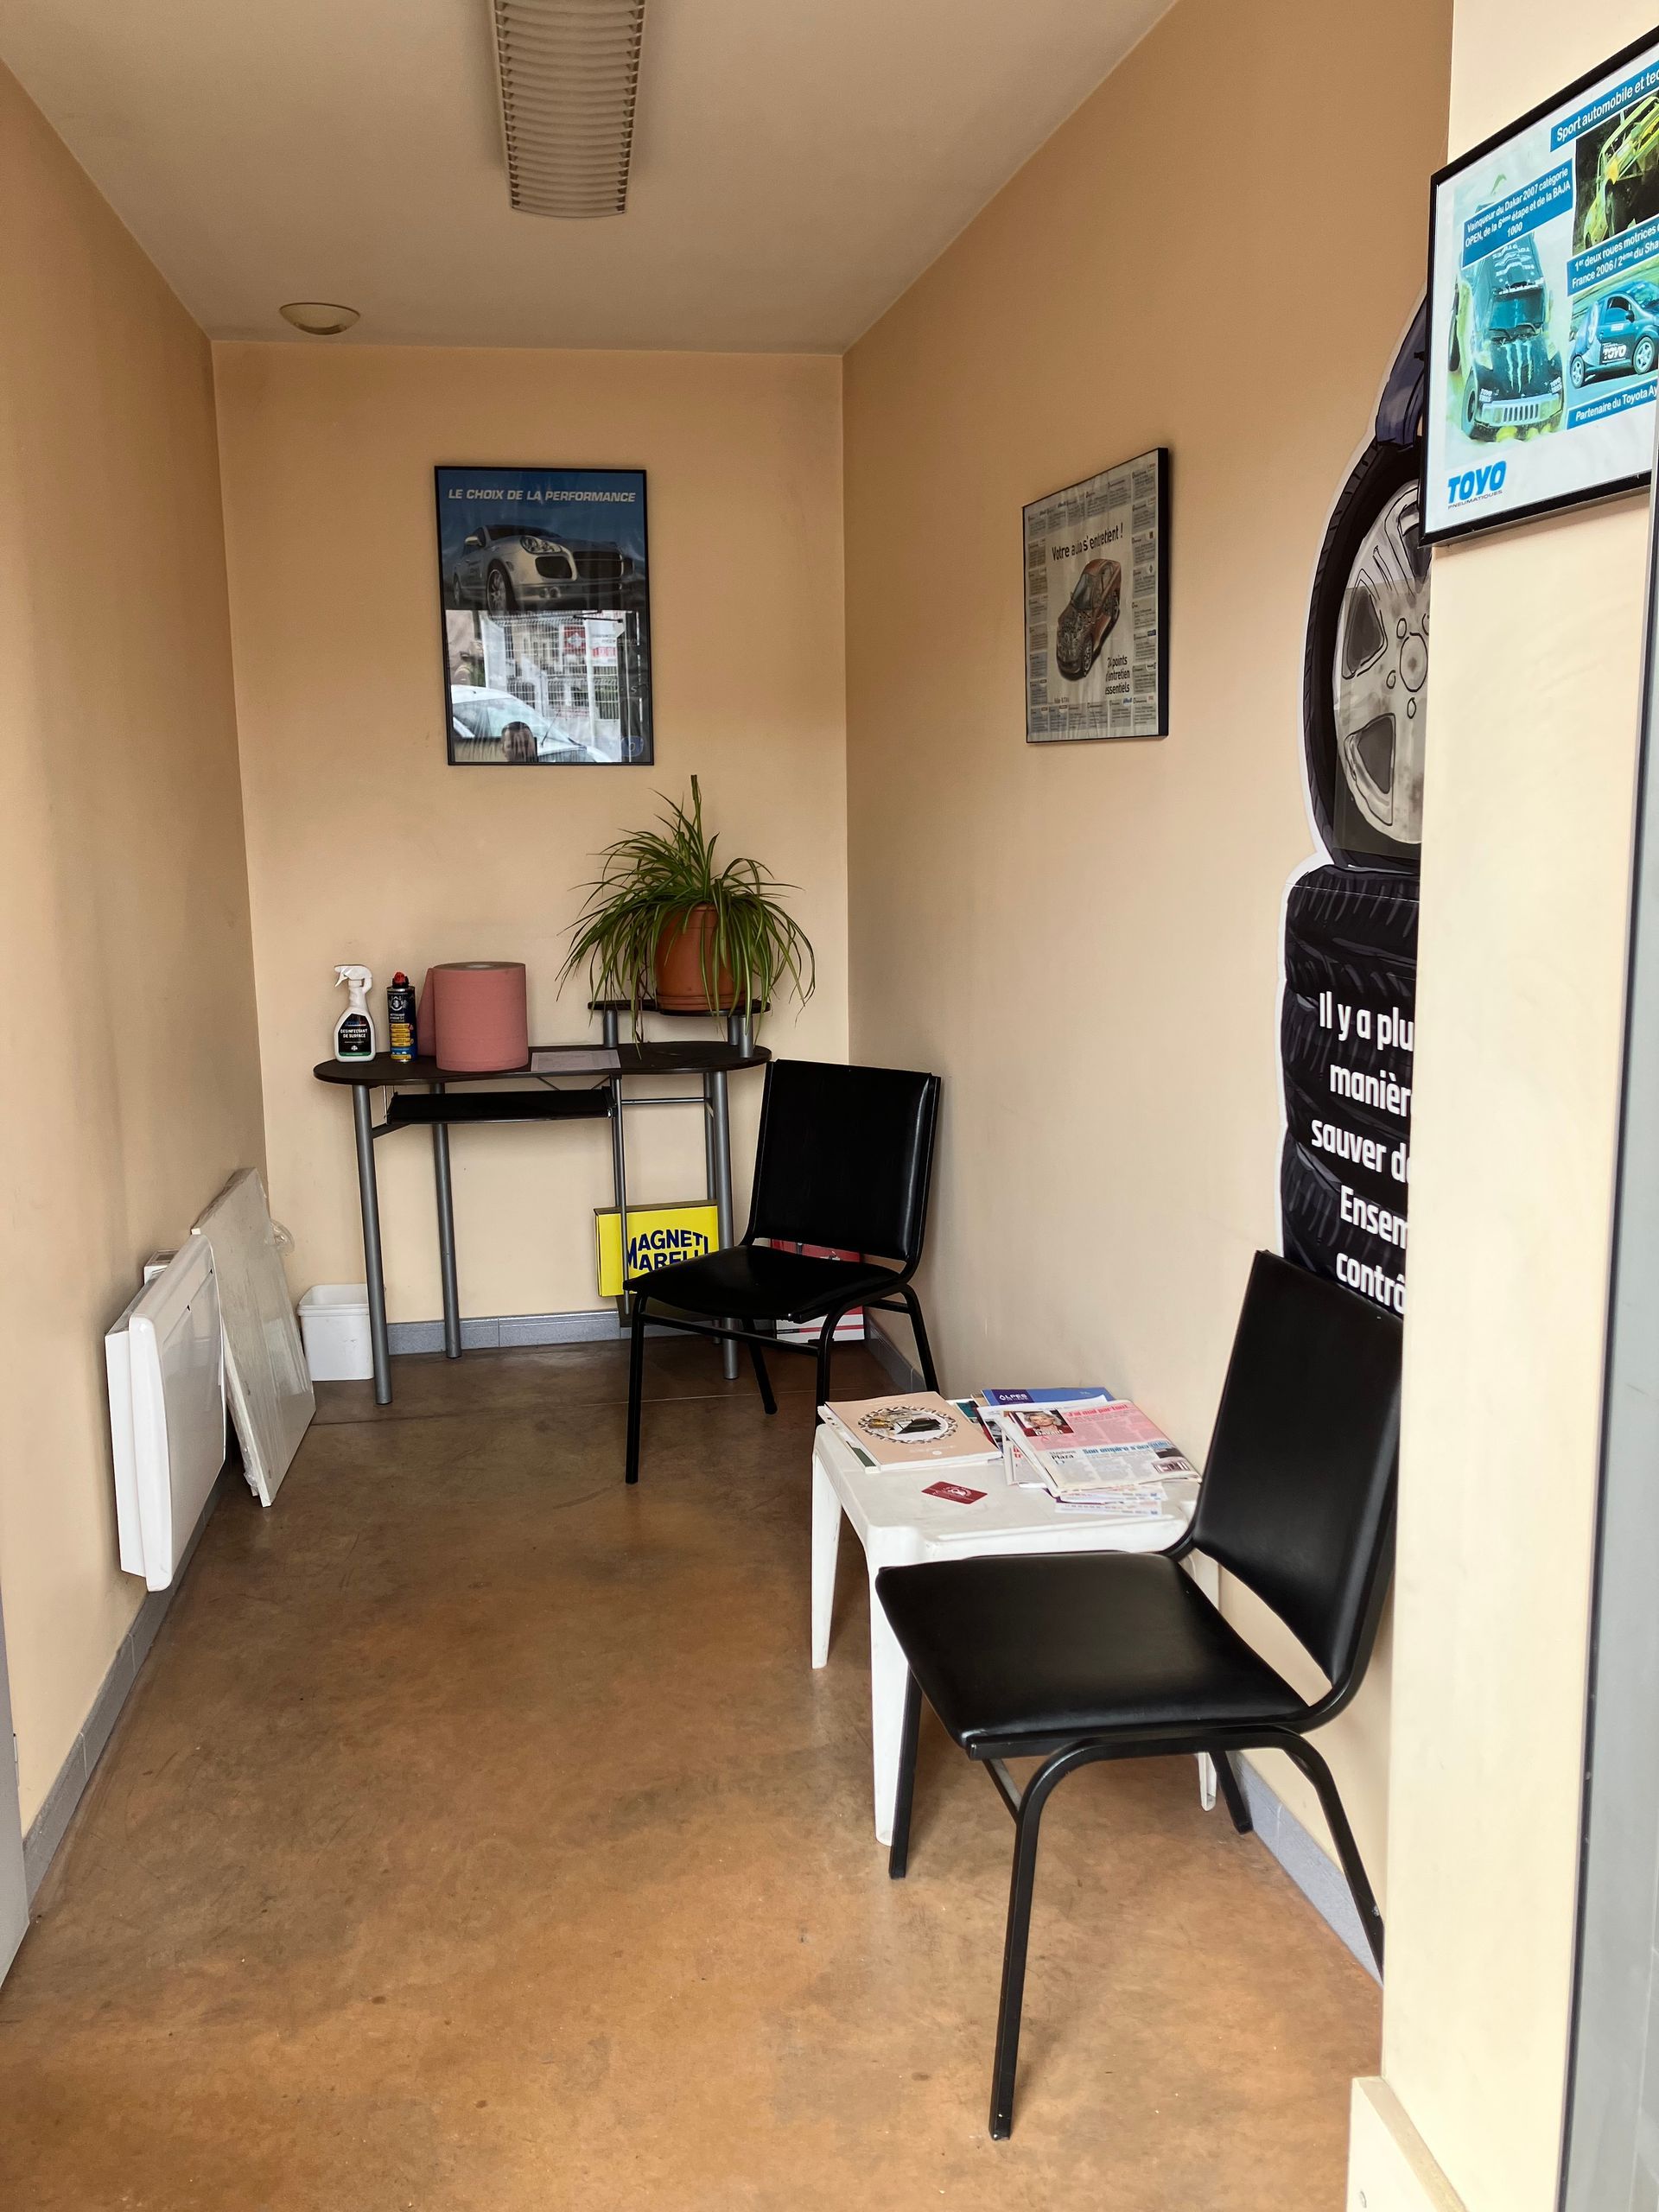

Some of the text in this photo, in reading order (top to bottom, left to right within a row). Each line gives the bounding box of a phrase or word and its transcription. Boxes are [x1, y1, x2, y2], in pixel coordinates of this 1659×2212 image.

[1557, 116, 1581, 142] Sport
[1582, 86, 1633, 126] automobile
[1634, 76, 1644, 93] et
[1465, 231, 1483, 248] OPEN,
[1483, 226, 1491, 237] de
[1491, 223, 1497, 232] la
[1511, 207, 1529, 222] étape
[1529, 200, 1536, 212] et
[1537, 196, 1545, 207] de
[1546, 192, 1553, 203] la
[1553, 180, 1571, 198] BAJA
[1467, 168, 1568, 232] Vainqueur du Dakar 2007 catégorie
[1507, 222, 1523, 237] 1000
[1575, 259, 1585, 272] 1er
[1584, 252, 1602, 267] deux
[1602, 242, 1623, 258] roues
[1624, 226, 1656, 248] motrices
[1572, 271, 1595, 289] France
[1596, 260, 1614, 277] 2006
[1634, 247, 1644, 258] du
[1603, 344, 1627, 360] TOYO
[1575, 402, 1612, 421] Partenaire
[1612, 398, 1621, 407] du
[1622, 389, 1648, 407] Toyota
[448, 489, 636, 502] LE CHOIX DE LA PERFORMANCE
[1448, 460, 1506, 504] TOYO
[1448, 490, 1503, 510] PNEUMATIQUES
[1052, 545, 1070, 561] Votre
[1112, 655, 1128, 670] points
[1319, 991, 1414, 1052] Il y a plu
[1330, 1064, 1412, 1117] manièr
[1311, 1119, 1410, 1184] sauver d
[628, 1229, 708, 1258] MAGNETI
[1336, 1252, 1406, 1315] contrô
